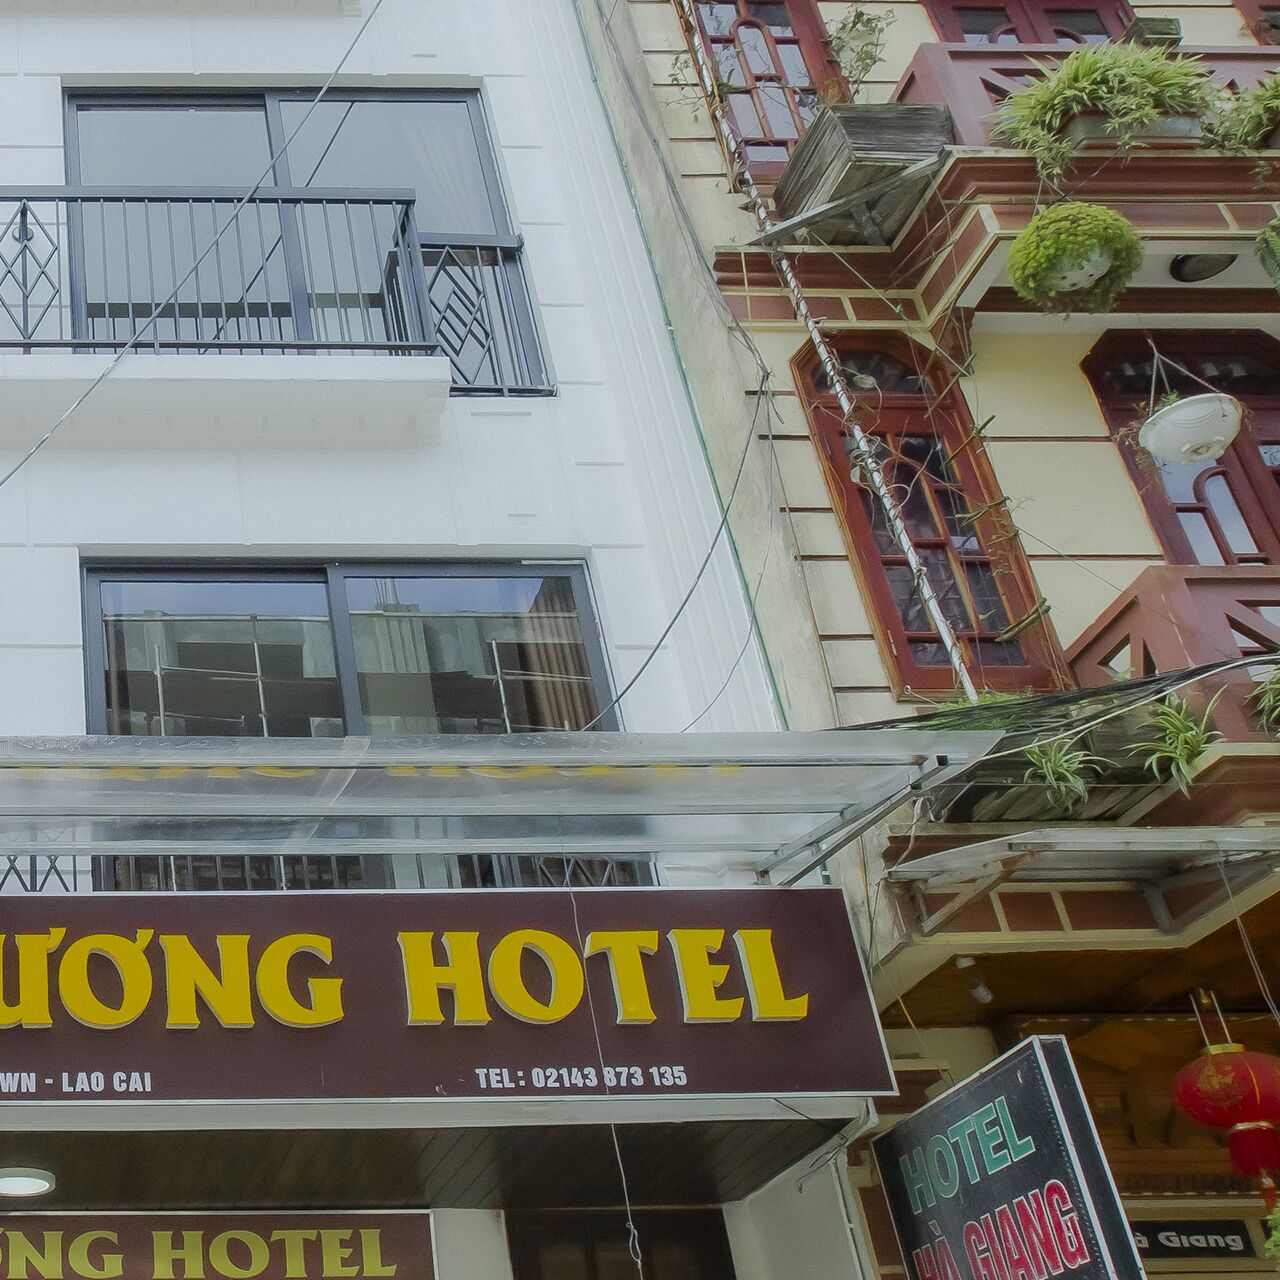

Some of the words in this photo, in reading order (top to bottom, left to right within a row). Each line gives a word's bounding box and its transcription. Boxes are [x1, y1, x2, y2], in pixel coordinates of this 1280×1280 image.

[398, 928, 809, 1026] HOTEL
[62, 1072, 105, 1093] LAO
[113, 1071, 152, 1092] CAI
[531, 1067, 597, 1088] 02143
[603, 1066, 644, 1087] 873
[649, 1065, 687, 1086] 135
[898, 1095, 1036, 1215] HOTEL
[151, 1228, 398, 1280] HOTEL
[1134, 1231, 1150, 1248] à
[1157, 1231, 1244, 1251] Giang
